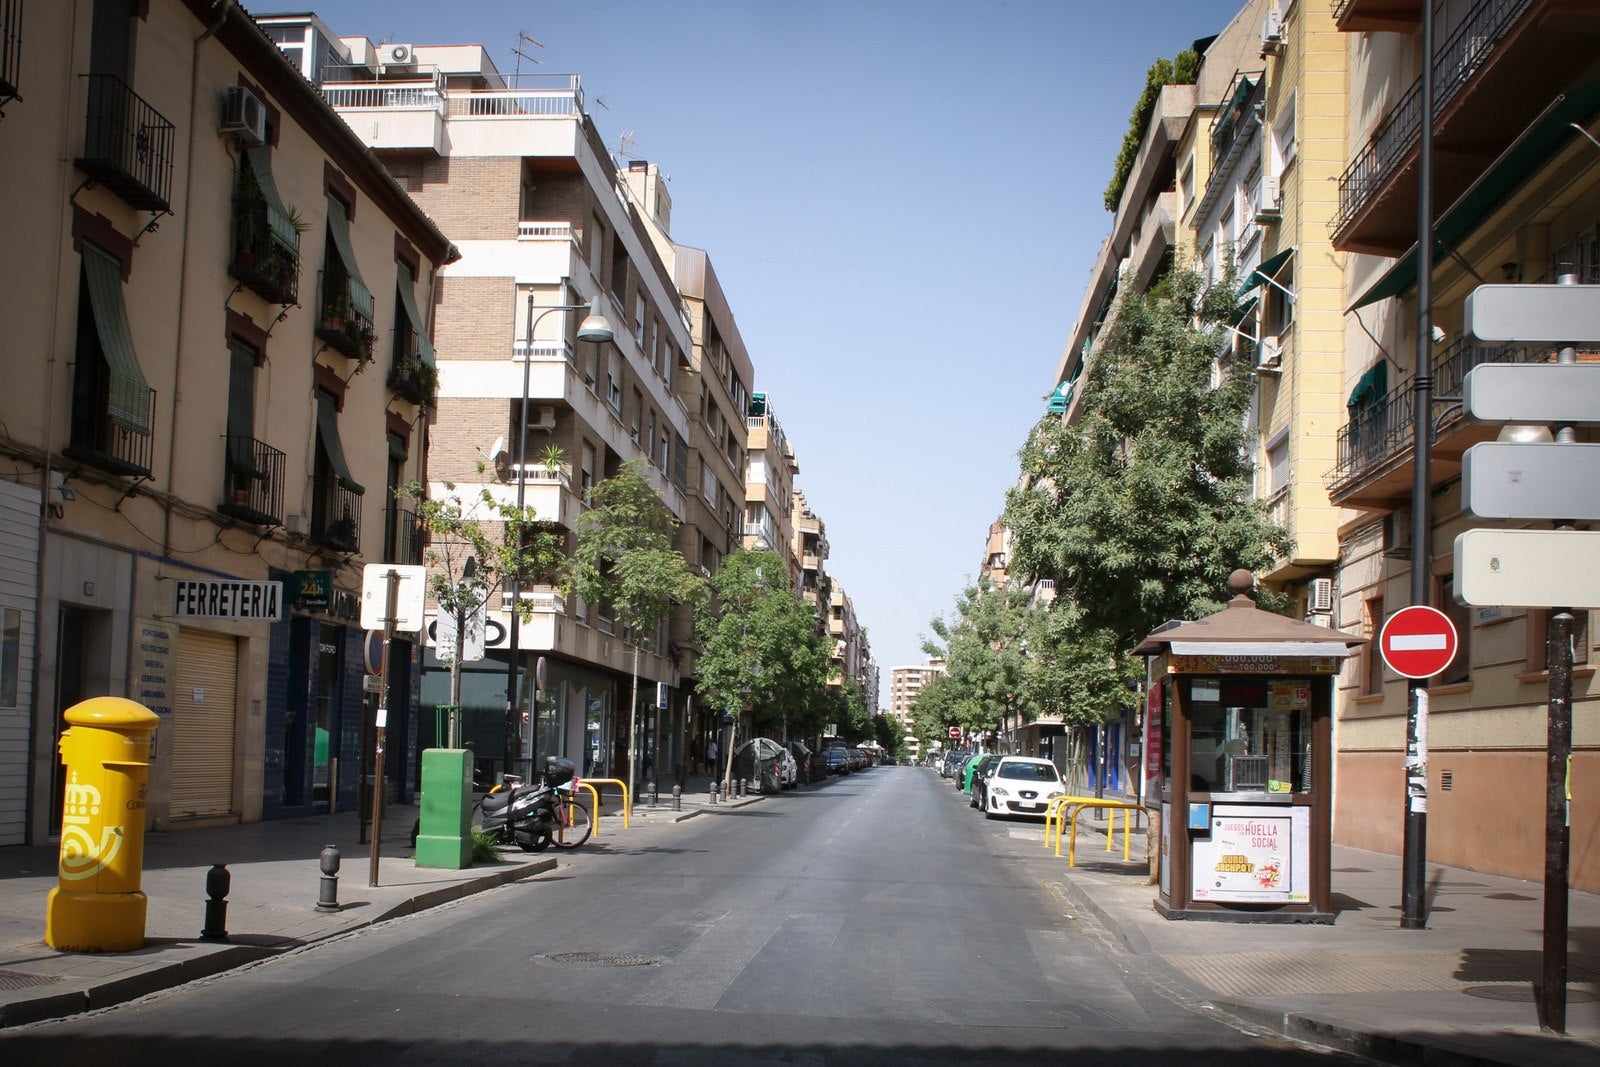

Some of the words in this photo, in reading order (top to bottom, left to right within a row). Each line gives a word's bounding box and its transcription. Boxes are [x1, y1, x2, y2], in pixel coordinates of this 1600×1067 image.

[301, 582, 324, 597] 24h
[175, 581, 277, 618] FERRETERIA
[1295, 689, 1307, 699] 15
[1223, 823, 1245, 832] JUEGOS
[1245, 820, 1278, 836] HUELLA
[1251, 837, 1278, 851] SOCIAL
[1222, 855, 1247, 864] EURO
[1215, 863, 1254, 873] JACKPOT
